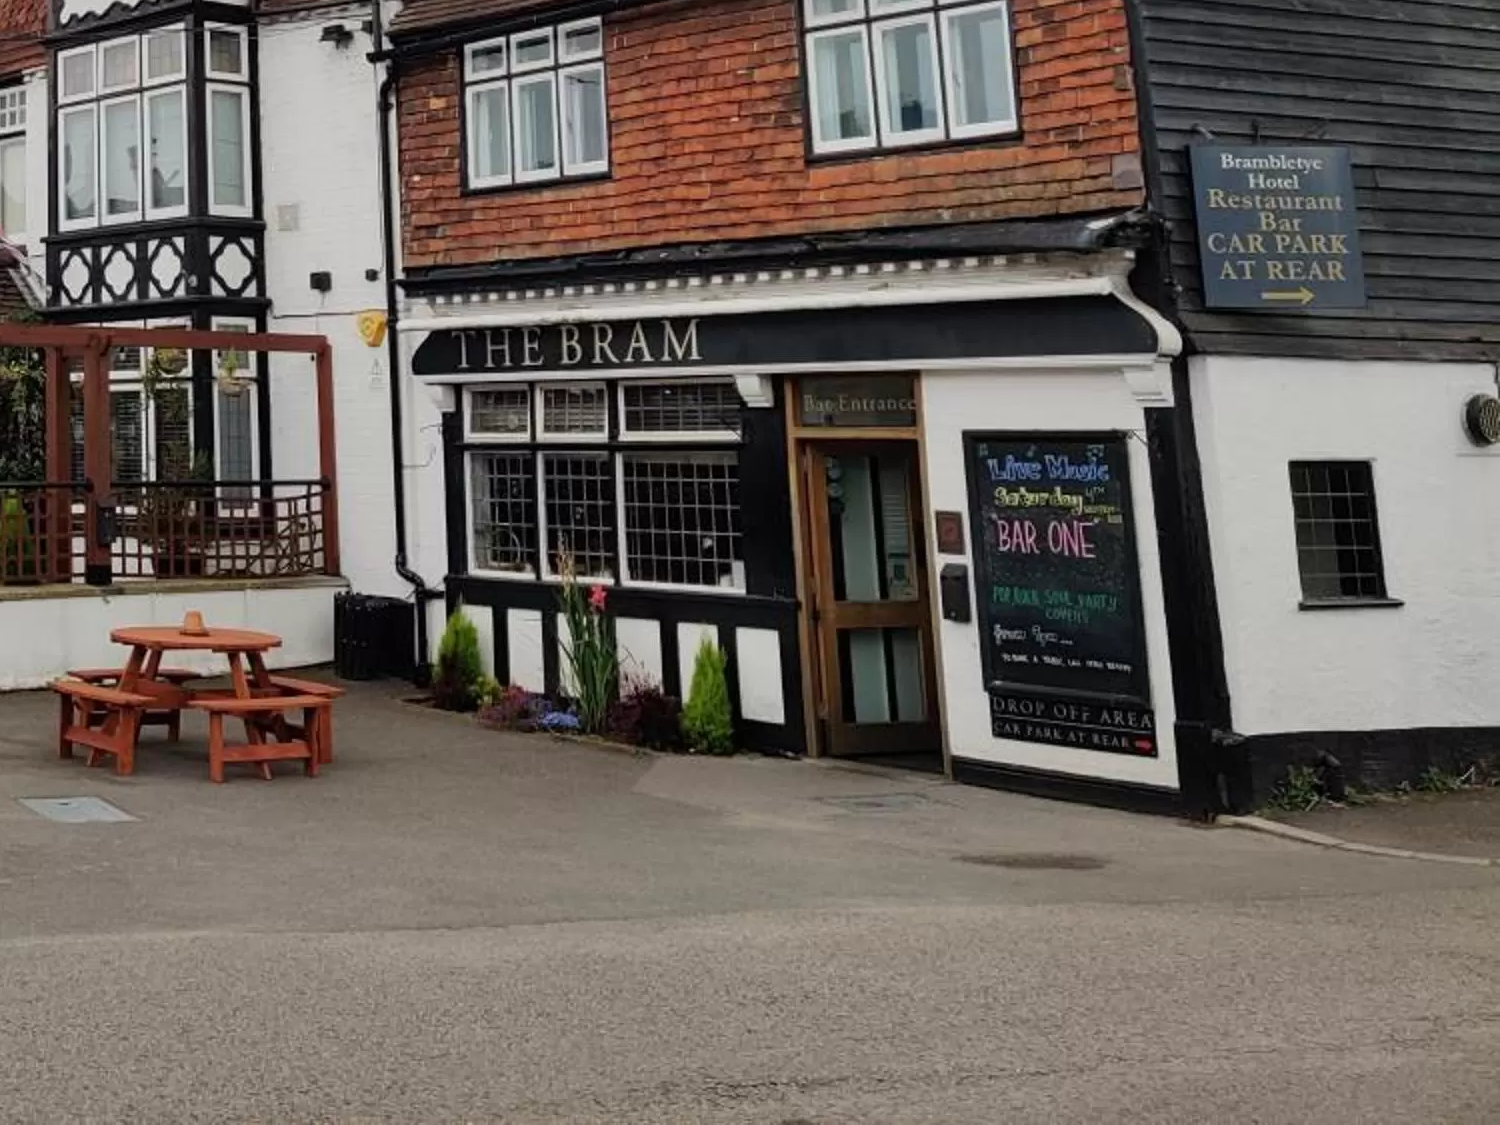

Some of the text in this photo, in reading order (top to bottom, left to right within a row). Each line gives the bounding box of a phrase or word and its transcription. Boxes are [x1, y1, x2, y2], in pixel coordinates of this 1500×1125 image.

[1220, 152, 1323, 173] Brambletye
[1248, 173, 1300, 189] Hotel
[1207, 188, 1344, 211] Restaurant
[1259, 212, 1302, 231] Bar
[1207, 232, 1349, 254] CAR PARK
[1219, 260, 1346, 281] AT REAR
[452, 319, 702, 368] THE BRAM
[838, 394, 917, 412] Entrance
[987, 454, 1042, 481] Live
[994, 486, 1083, 515] Saturday
[992, 696, 1154, 728] DROP OFF AREA
[994, 722, 1130, 748] CAR PARK AT REAR
